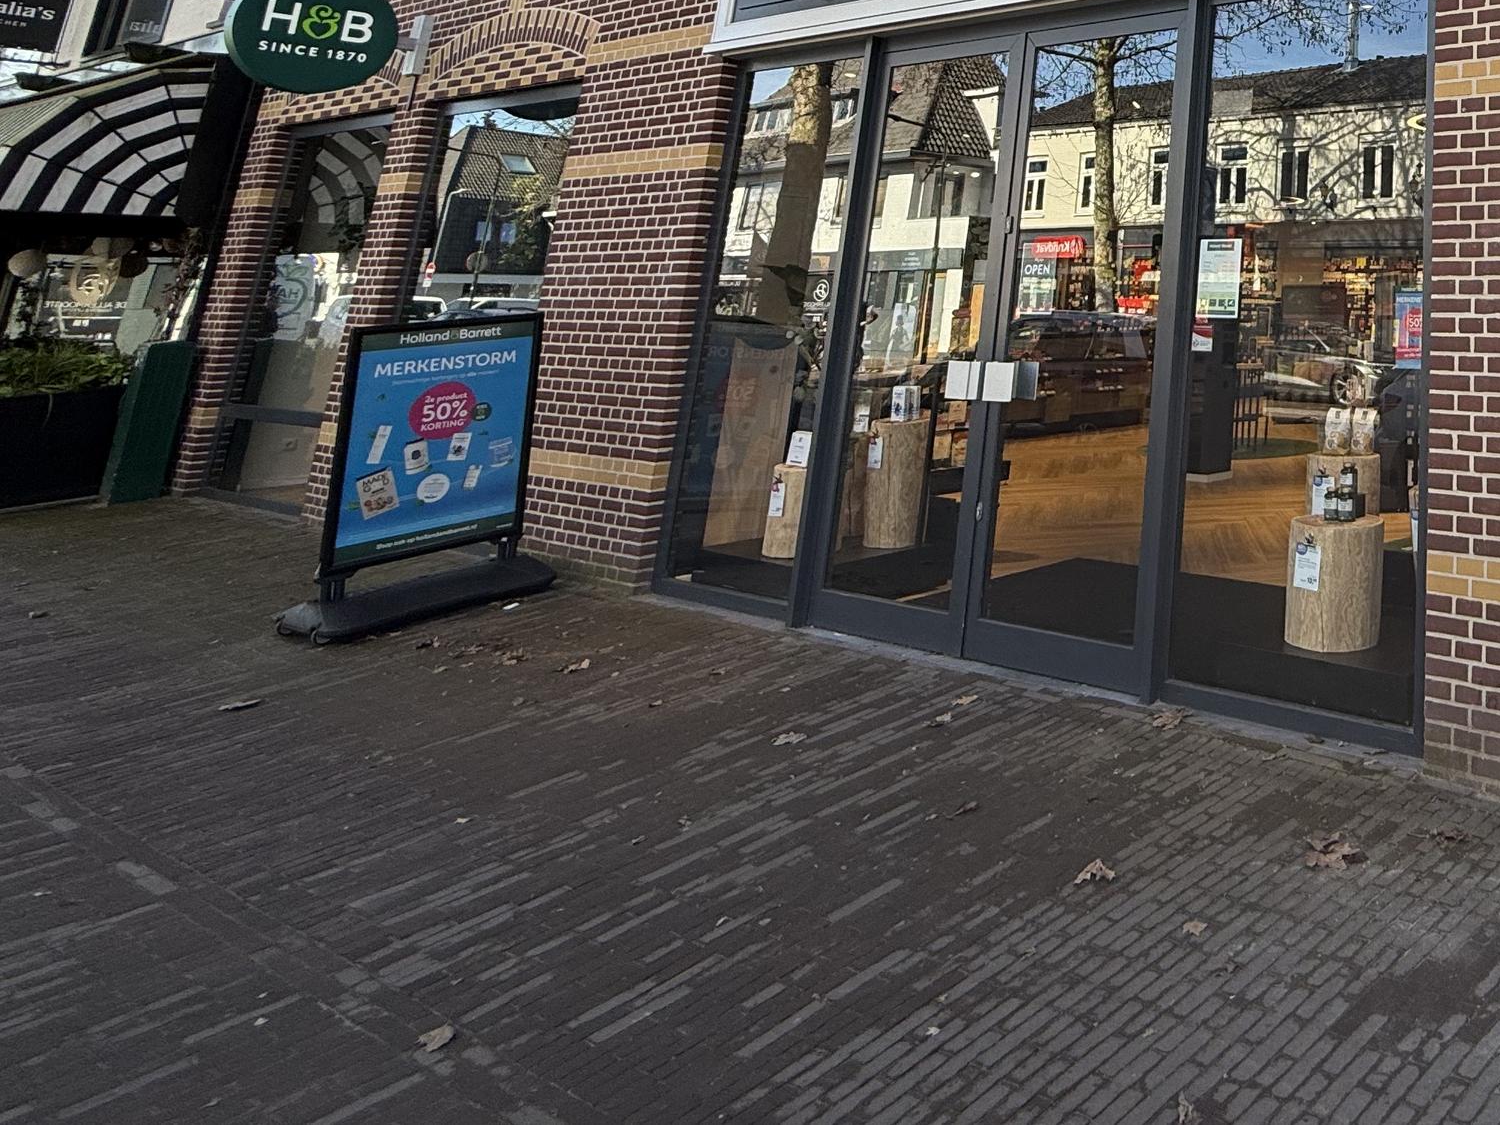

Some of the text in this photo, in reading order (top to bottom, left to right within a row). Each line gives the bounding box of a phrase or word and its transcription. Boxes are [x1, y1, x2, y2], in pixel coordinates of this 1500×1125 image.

[258, 40, 368, 63] SINCE 1870
[1024, 264, 1050, 275] OPEN
[374, 350, 517, 378] MERKENSTORM
[424, 391, 468, 405] 2e product
[421, 399, 468, 423] 50%
